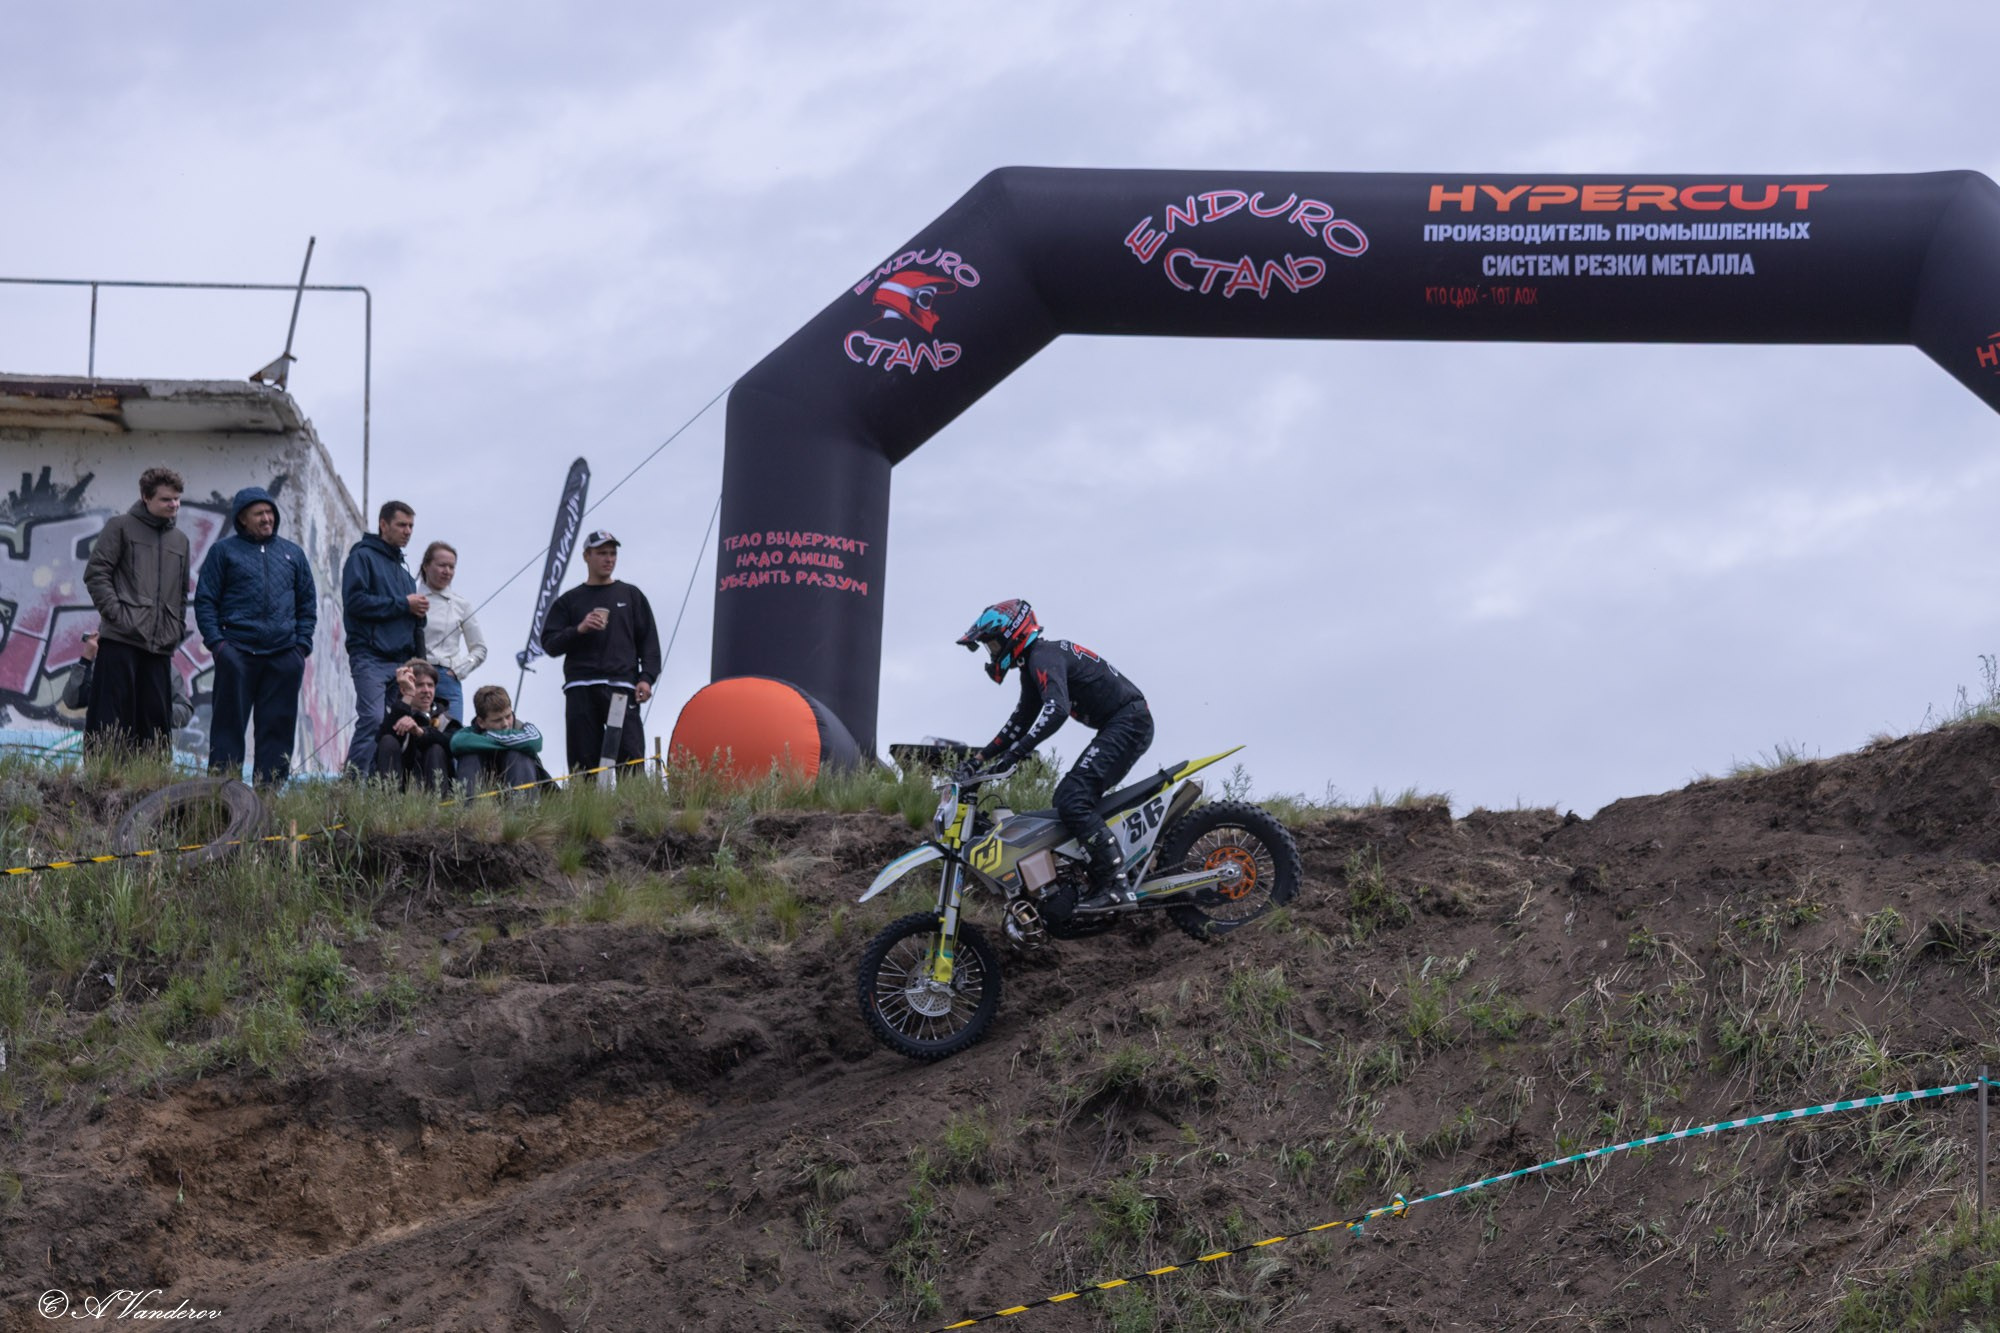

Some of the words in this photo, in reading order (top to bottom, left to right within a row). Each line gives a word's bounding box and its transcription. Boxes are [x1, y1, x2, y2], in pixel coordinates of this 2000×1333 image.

[1427, 183, 1829, 213] HYPERCUT
[1124, 189, 1369, 264] ENDURO
[1423, 223, 1611, 245] ПРОИЗВОДИТЕЛЬ
[1615, 221, 1811, 241] ПРОМЫШЛЕННЫХ
[853, 248, 981, 296] ENDURO
[1482, 254, 1569, 277] СИСТЕМ
[1574, 254, 1647, 276] РЕЗКИ
[1652, 253, 1755, 276] МЕТАЛЛА
[1425, 287, 1448, 305] КТО
[1490, 287, 1511, 305] ТОТ
[723, 532, 762, 552] ТЕЛО
[765, 531, 869, 556] ВЫДЕРЖИТ
[735, 550, 784, 568] НАДО
[787, 550, 844, 570] ЛИШЬ
[719, 570, 791, 591] УБЕДИТЬ
[795, 571, 868, 596] РАЗУМ
